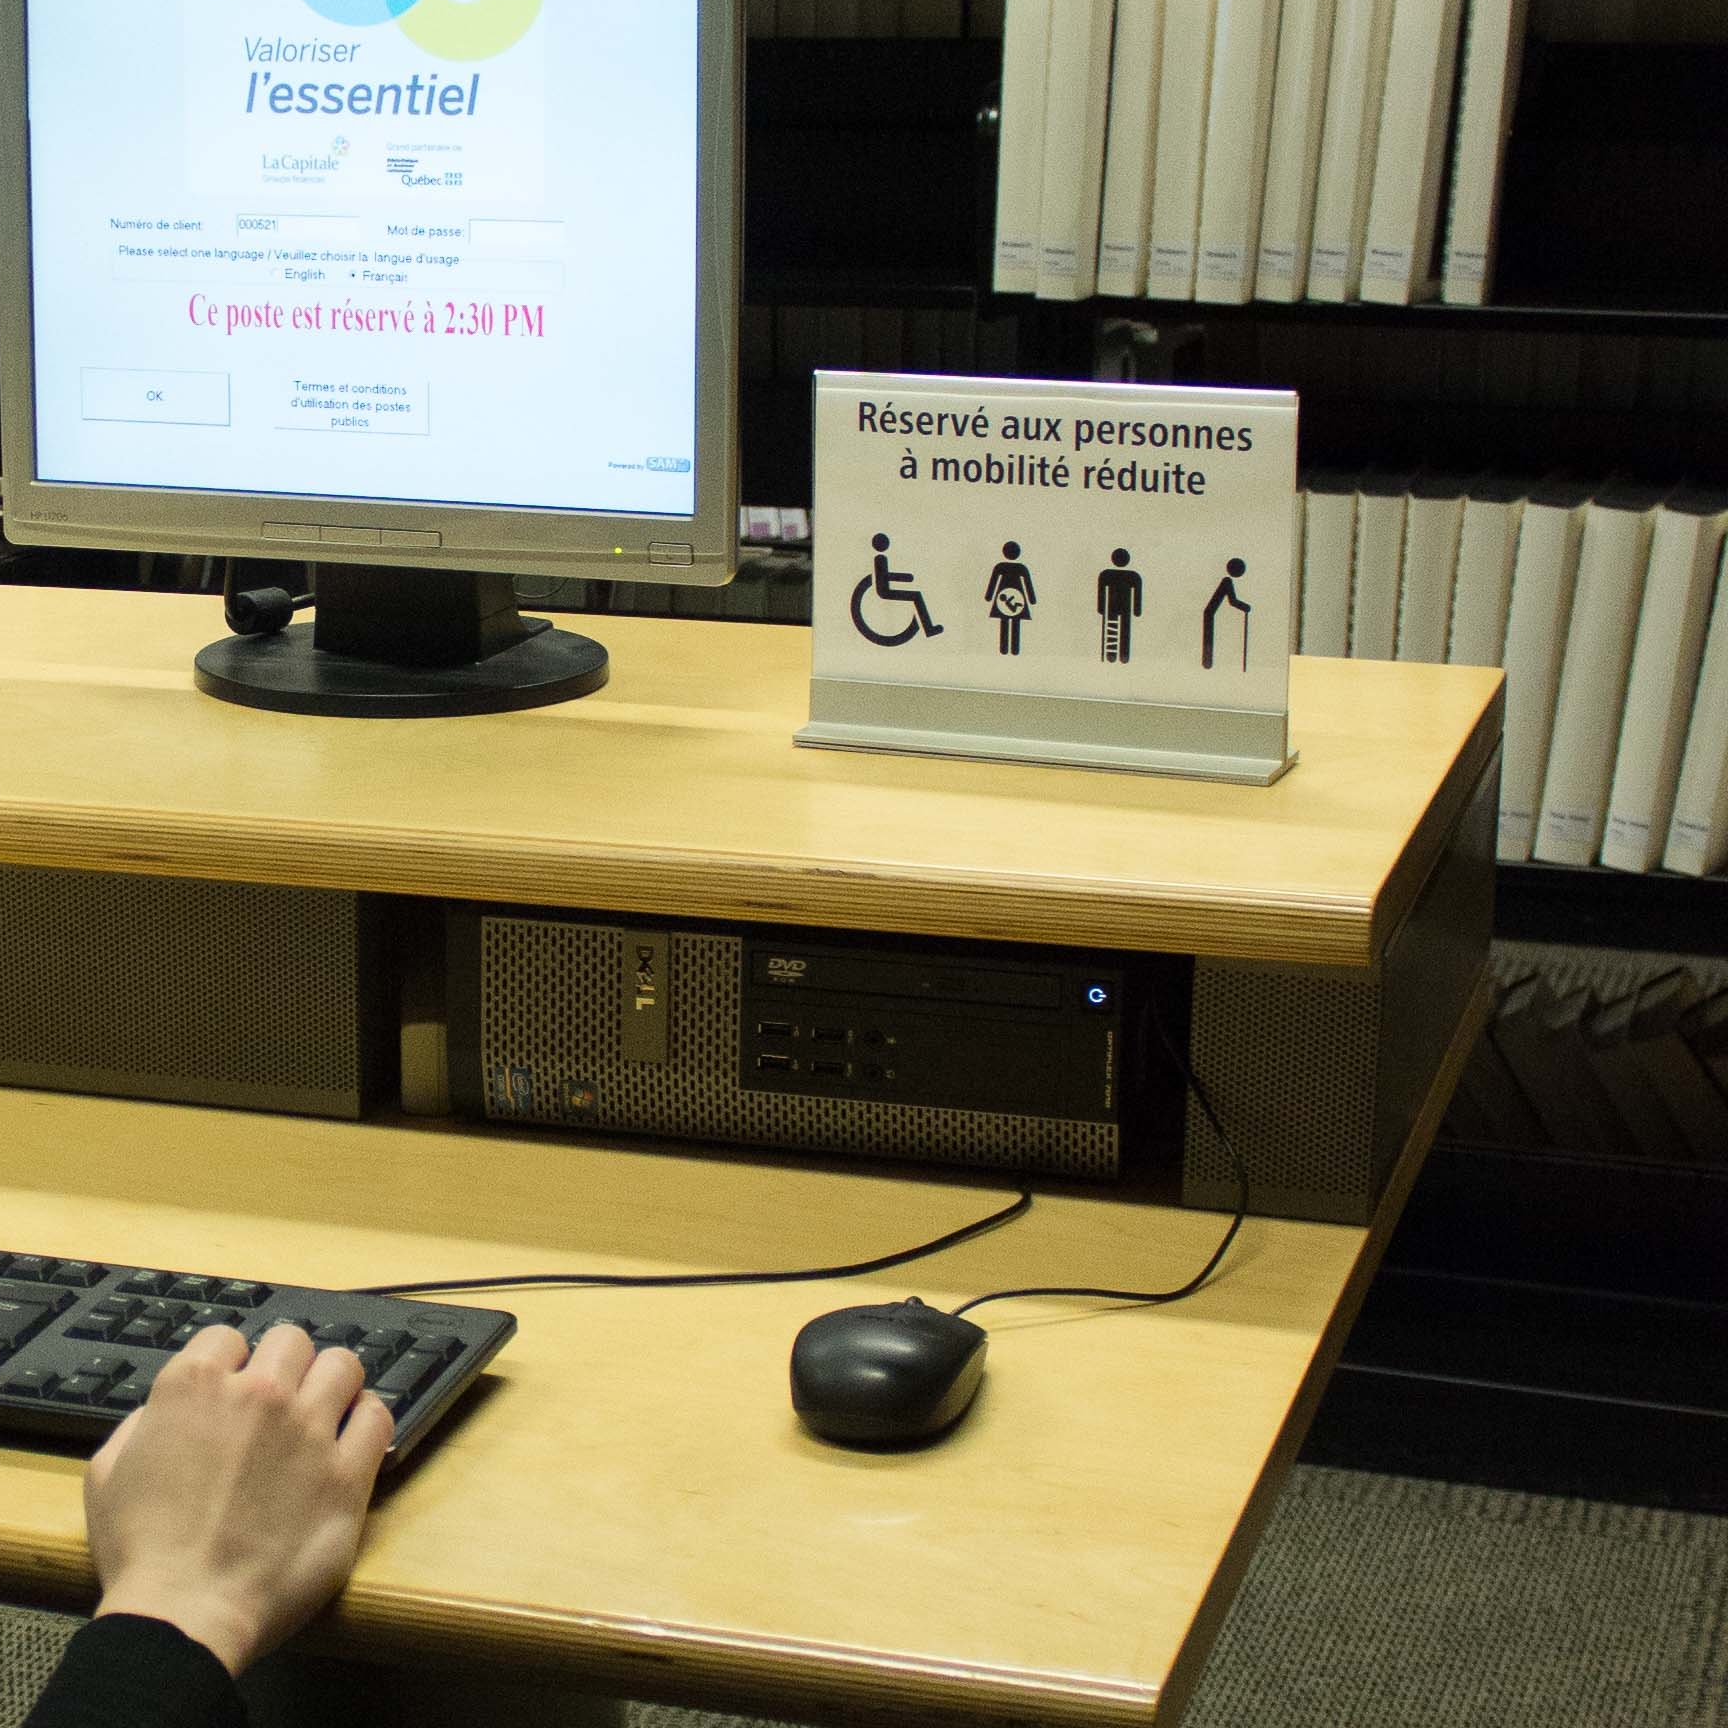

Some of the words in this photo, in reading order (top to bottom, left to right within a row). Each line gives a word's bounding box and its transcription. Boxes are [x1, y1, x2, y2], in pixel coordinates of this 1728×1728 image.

[244, 36, 361, 63] Valoriser
[245, 72, 480, 115] l'essentiel
[401, 174, 442, 187] Québec
[110, 217, 153, 230] Numéro
[156, 219, 170, 230] de
[387, 225, 409, 237] Mot
[411, 225, 425, 237] de
[119, 244, 154, 257] Please
[157, 246, 188, 258] select
[191, 248, 211, 259] one
[214, 248, 265, 262] language
[274, 249, 318, 261] Veuillez
[320, 250, 356, 262] choisir
[358, 251, 369, 262] la
[374, 251, 412, 265] langue
[415, 253, 460, 267] d'usage
[284, 268, 326, 282] English
[362, 270, 409, 285] Français
[189, 292, 218, 327] Ce
[226, 300, 284, 336] poste
[292, 301, 322, 330] est
[331, 298, 415, 334] réservé
[423, 300, 436, 334] à
[445, 302, 493, 336] 2:30
[503, 303, 545, 337] PM
[294, 380, 335, 393] Termes
[338, 383, 349, 393] et
[351, 383, 408, 396] conditions
[146, 390, 163, 402] OK
[290, 397, 349, 411] d'utilisation
[352, 399, 372, 412] des
[375, 401, 412, 415] postes
[330, 416, 370, 429] publics
[857, 401, 990, 441] Réservé
[1001, 412, 1062, 443] aux
[1074, 417, 1254, 452] personnes
[899, 448, 918, 480] à
[931, 451, 1071, 489] mobilité
[1082, 458, 1207, 496] réduite
[767, 957, 808, 971] DVD
